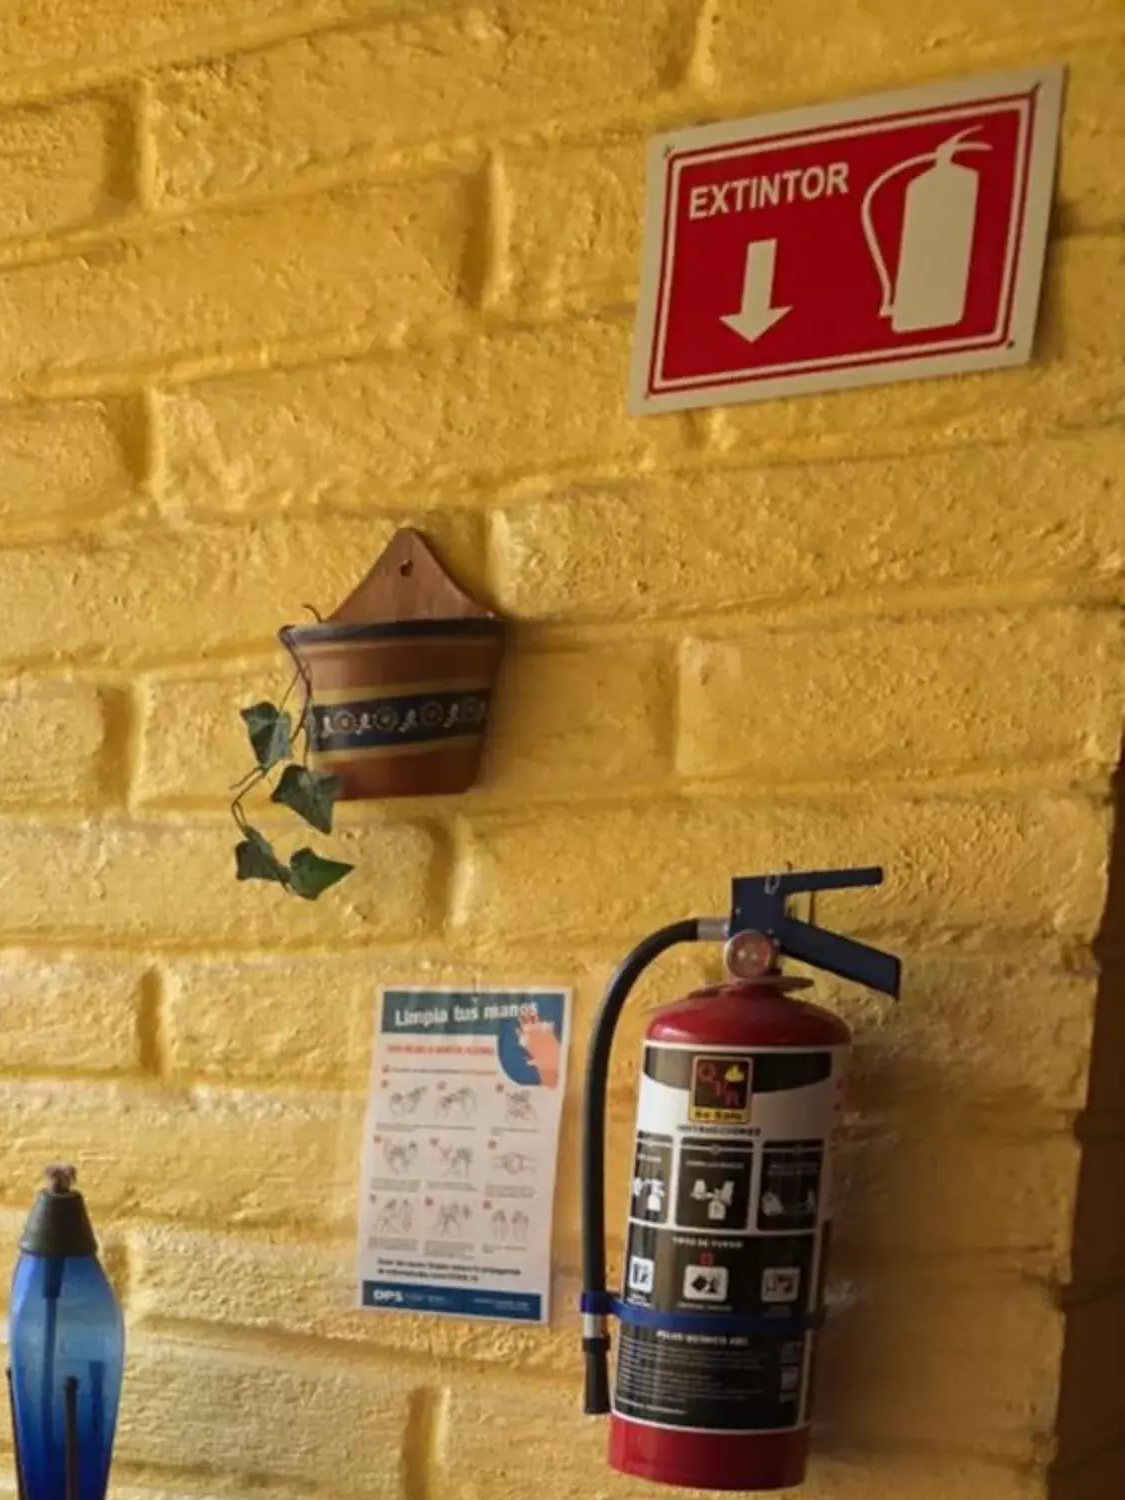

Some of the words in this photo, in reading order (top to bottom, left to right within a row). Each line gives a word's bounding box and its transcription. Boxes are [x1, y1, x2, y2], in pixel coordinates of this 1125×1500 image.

[689, 162, 849, 220] EXTINTOR
[395, 1008, 449, 1027] Limpia
[454, 1005, 479, 1020] tus
